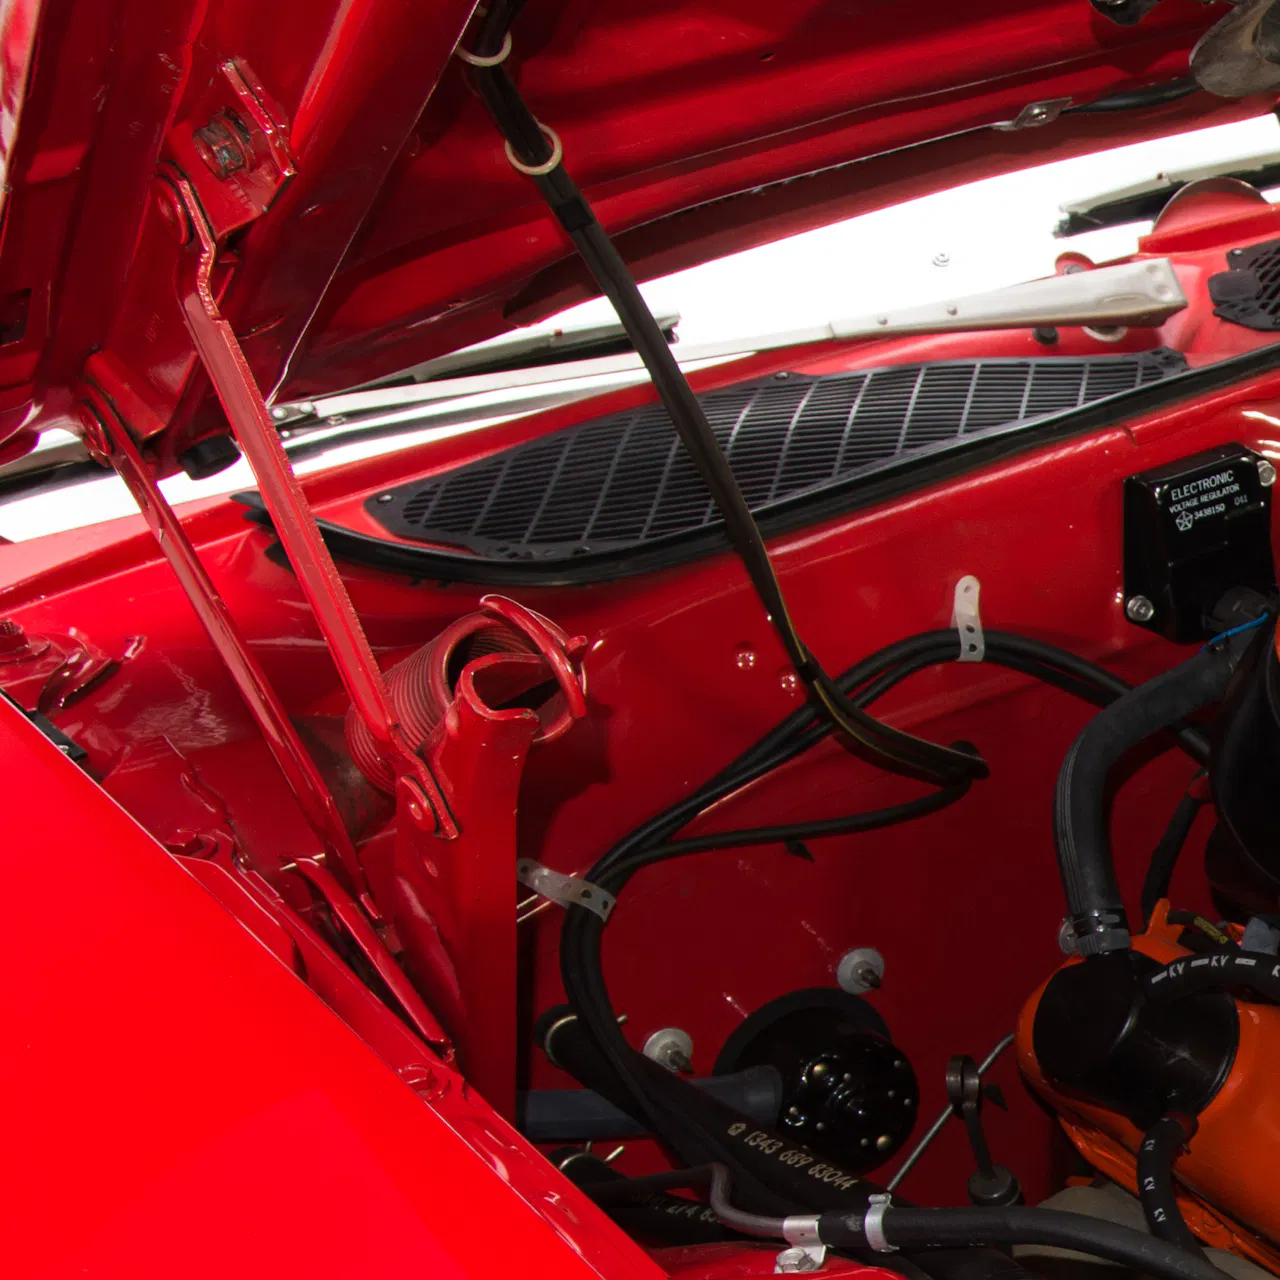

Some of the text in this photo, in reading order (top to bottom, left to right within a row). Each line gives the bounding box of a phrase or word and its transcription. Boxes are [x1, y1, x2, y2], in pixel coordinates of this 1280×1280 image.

[1169, 484, 1240, 513] VOLTAGE REGULATOR
[1171, 470, 1234, 501] ELECTRONIC
[1194, 504, 1225, 520] 3438150
[1169, 962, 1185, 978] KV
[1211, 955, 1229, 967] KV
[744, 1131, 783, 1154] 1343
[808, 1163, 859, 1190] 83044
